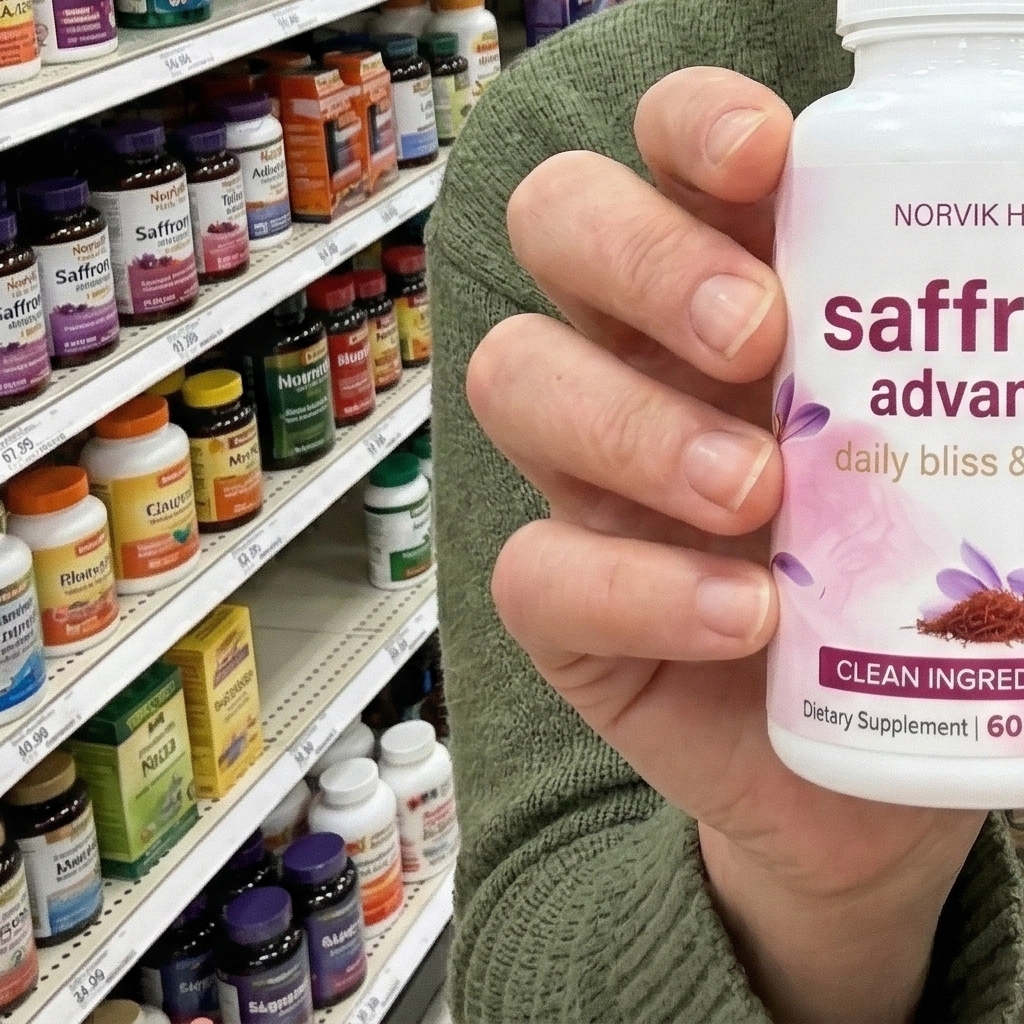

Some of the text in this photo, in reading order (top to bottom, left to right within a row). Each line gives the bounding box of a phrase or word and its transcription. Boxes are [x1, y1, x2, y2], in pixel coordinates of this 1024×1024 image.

[894, 203, 999, 227] NORVIK
[55, 257, 110, 285] Saffron
[834, 440, 909, 483] daily
[920, 443, 998, 477] bliss
[836, 659, 920, 690] CLEAN
[803, 698, 853, 732] Dietary
[857, 710, 969, 738] Supplement
[986, 714, 1023, 738] 60
